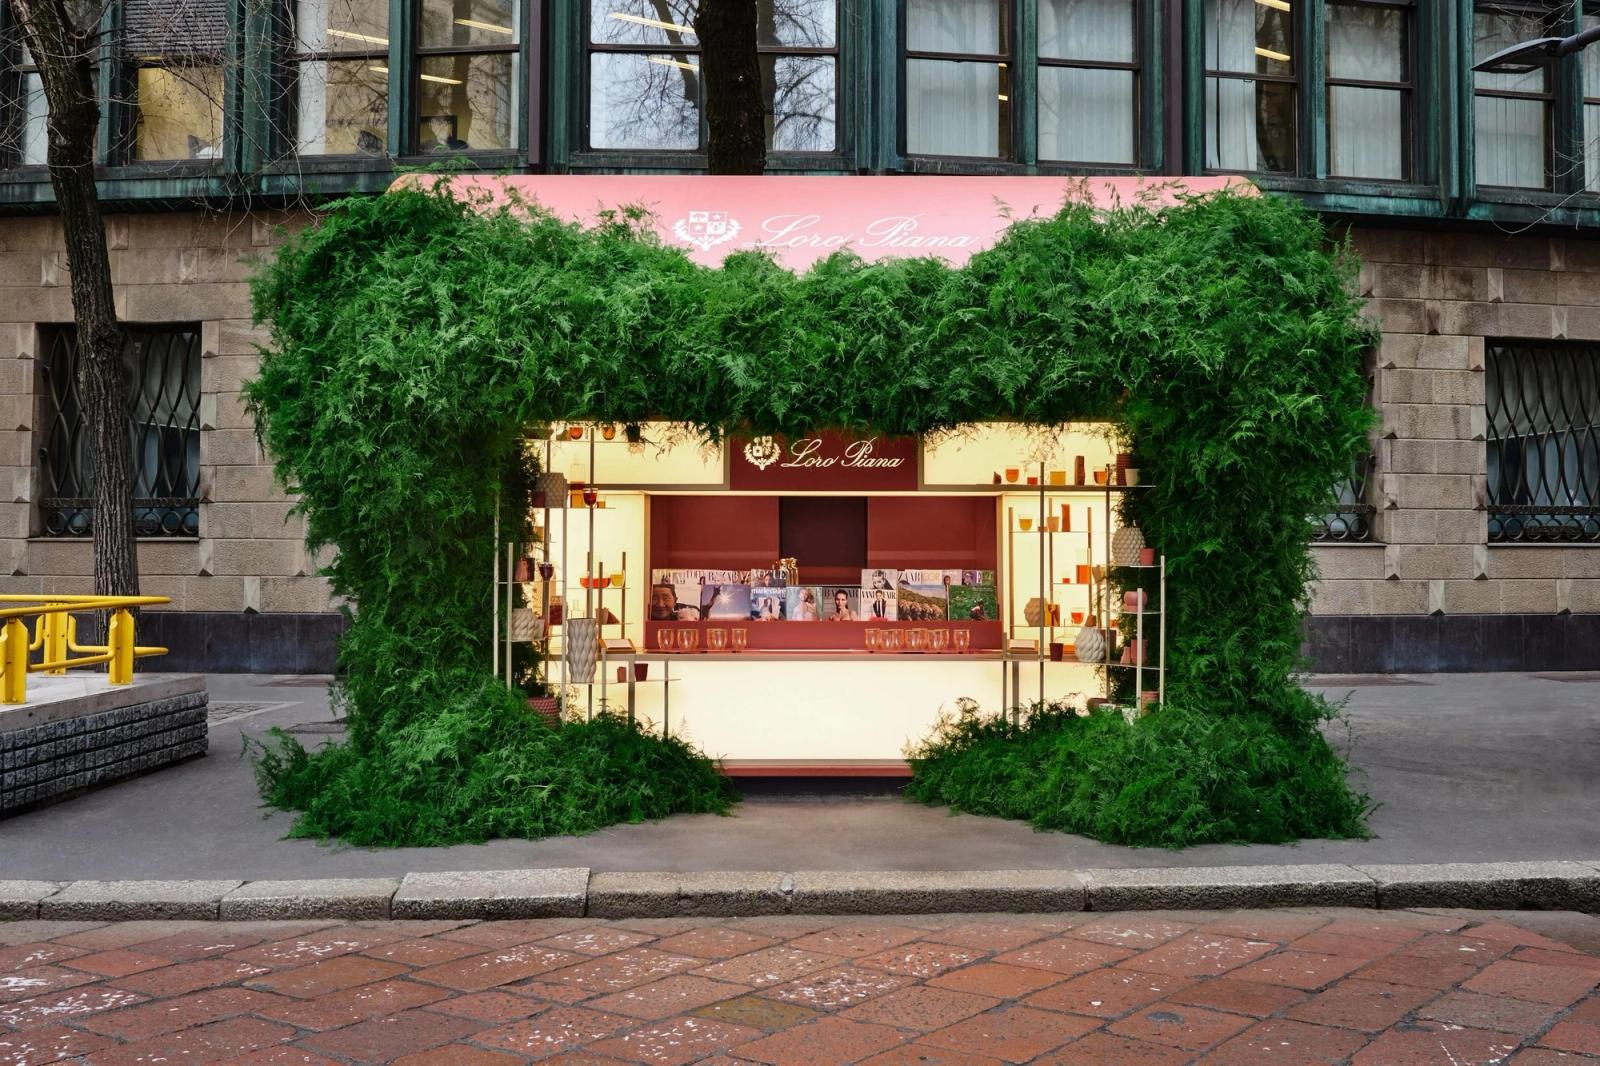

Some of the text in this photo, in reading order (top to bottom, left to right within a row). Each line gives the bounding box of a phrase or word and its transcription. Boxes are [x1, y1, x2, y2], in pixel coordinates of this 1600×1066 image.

[743, 212, 981, 248] Loro Piana
[780, 436, 905, 468] Loro Piana
